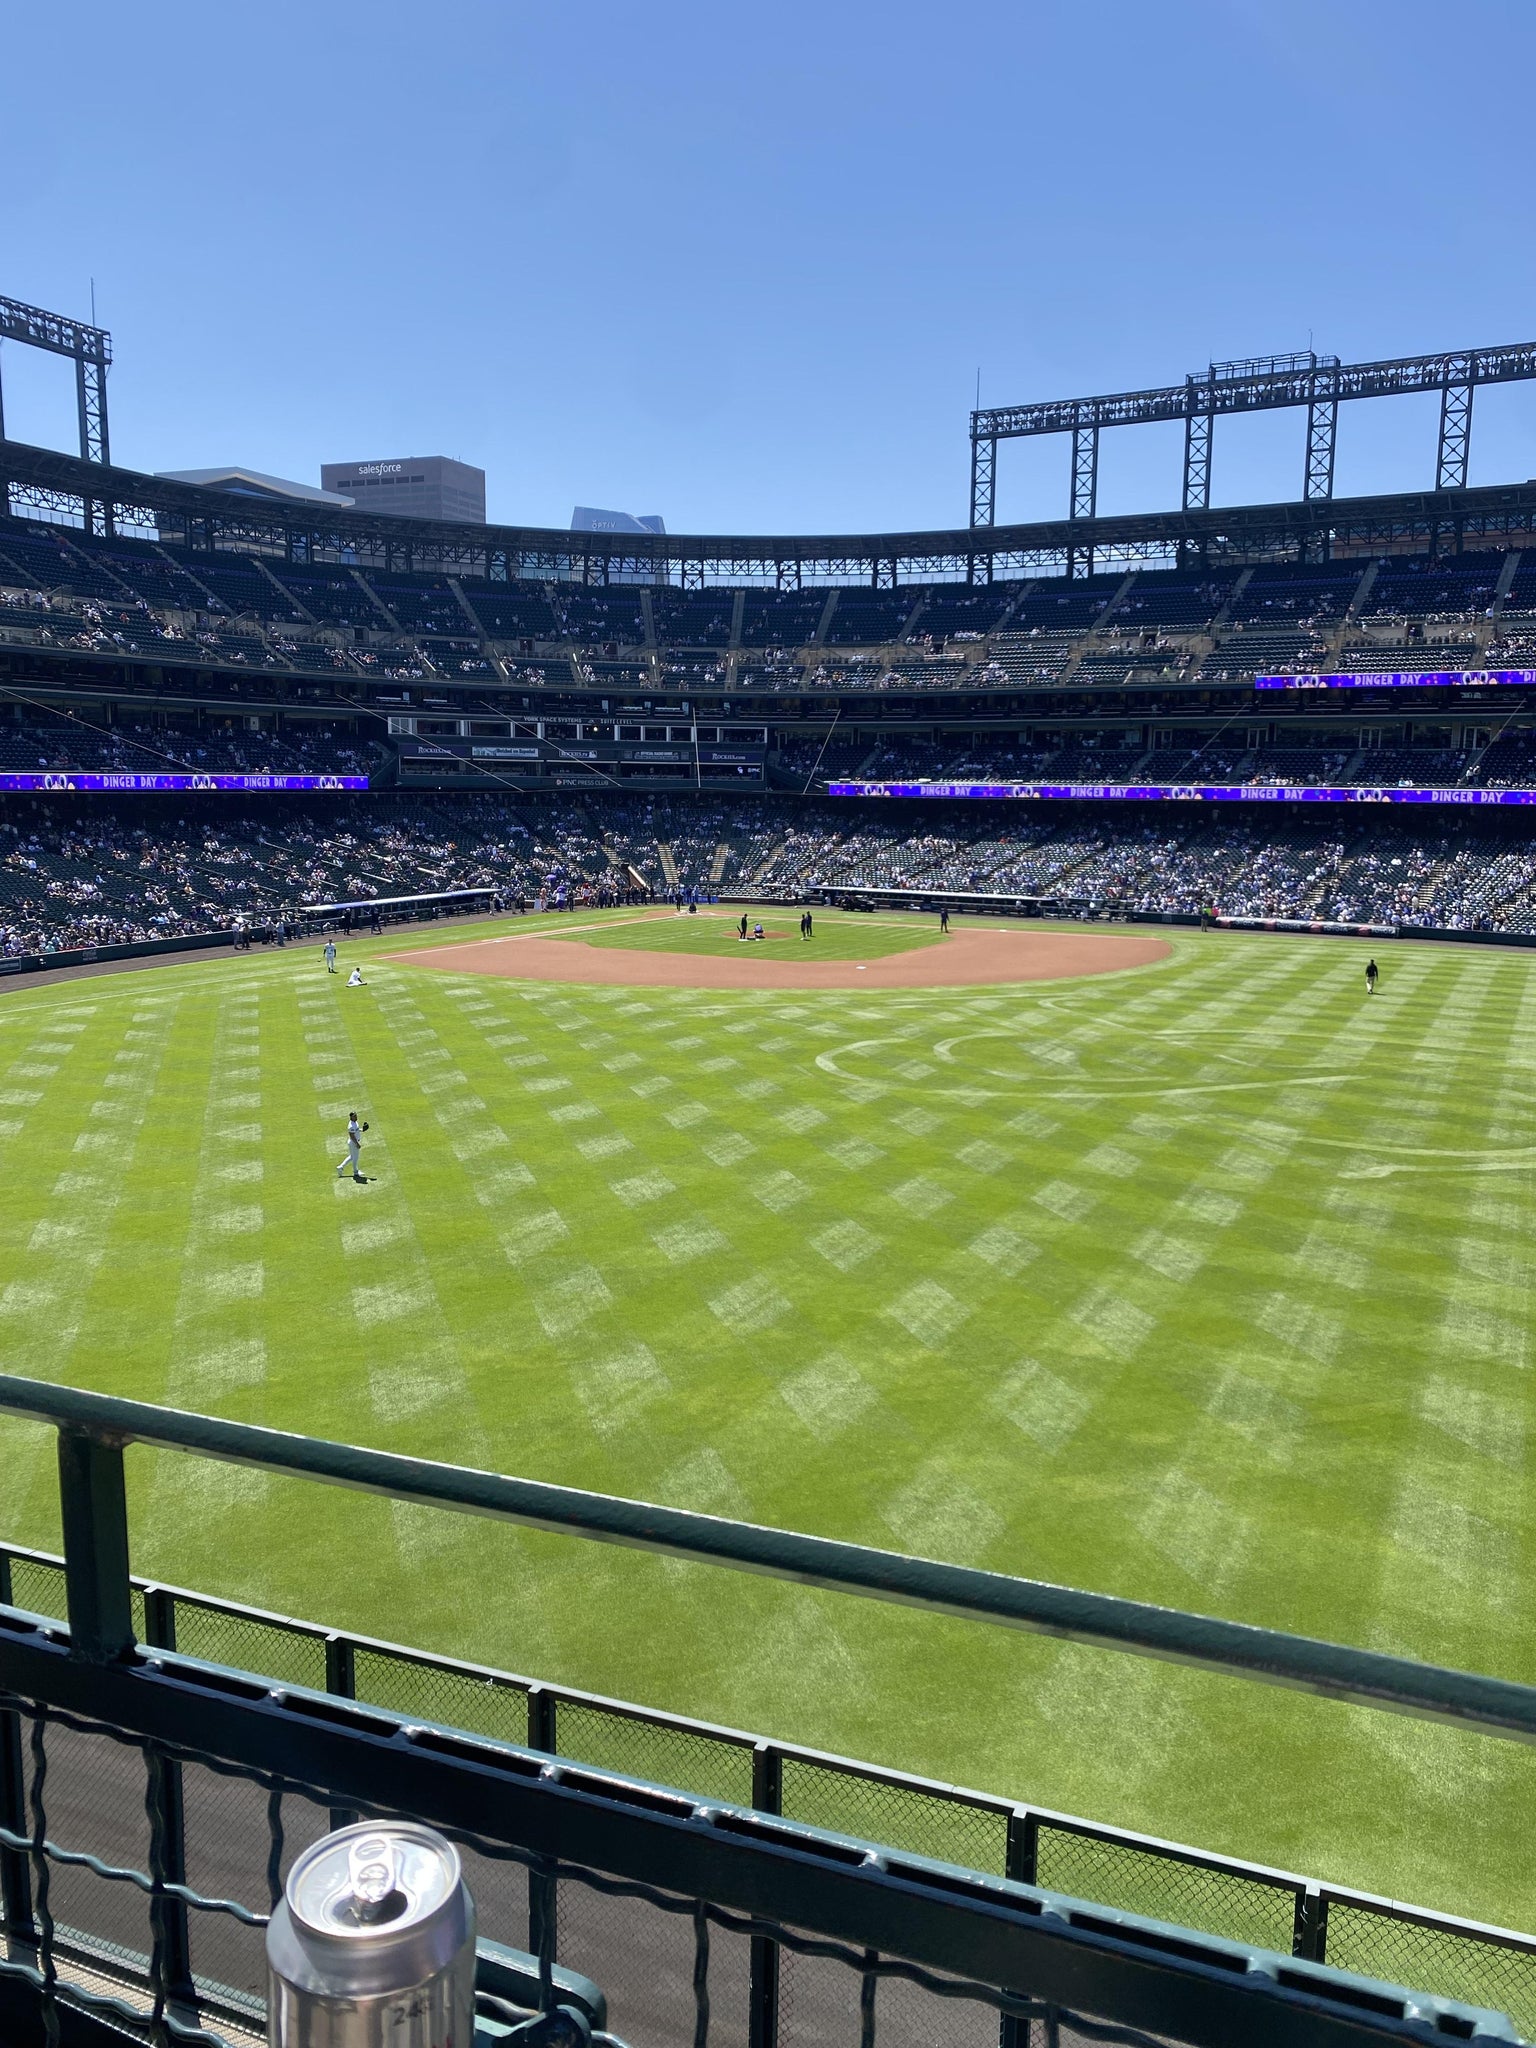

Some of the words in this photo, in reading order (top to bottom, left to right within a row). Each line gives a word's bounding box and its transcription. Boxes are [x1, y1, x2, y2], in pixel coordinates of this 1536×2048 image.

[358, 463, 401, 476] salesforce
[592, 520, 616, 529] OPTIV
[1354, 675, 1394, 685] DINGER
[1400, 674, 1421, 685] DAY
[103, 776, 135, 788] DINGER
[141, 776, 157, 788] DAY
[244, 777, 270, 787] DINGER
[274, 777, 288, 787] DAY
[920, 786, 950, 796] DINGER
[955, 787, 971, 796] DAY
[1070, 787, 1104, 797] DINGER
[1110, 788, 1128, 797] DAY
[1240, 789, 1278, 799] DINGER
[1284, 789, 1305, 799] DAY
[1431, 791, 1473, 802] DINGER
[1481, 792, 1505, 803] DAY
